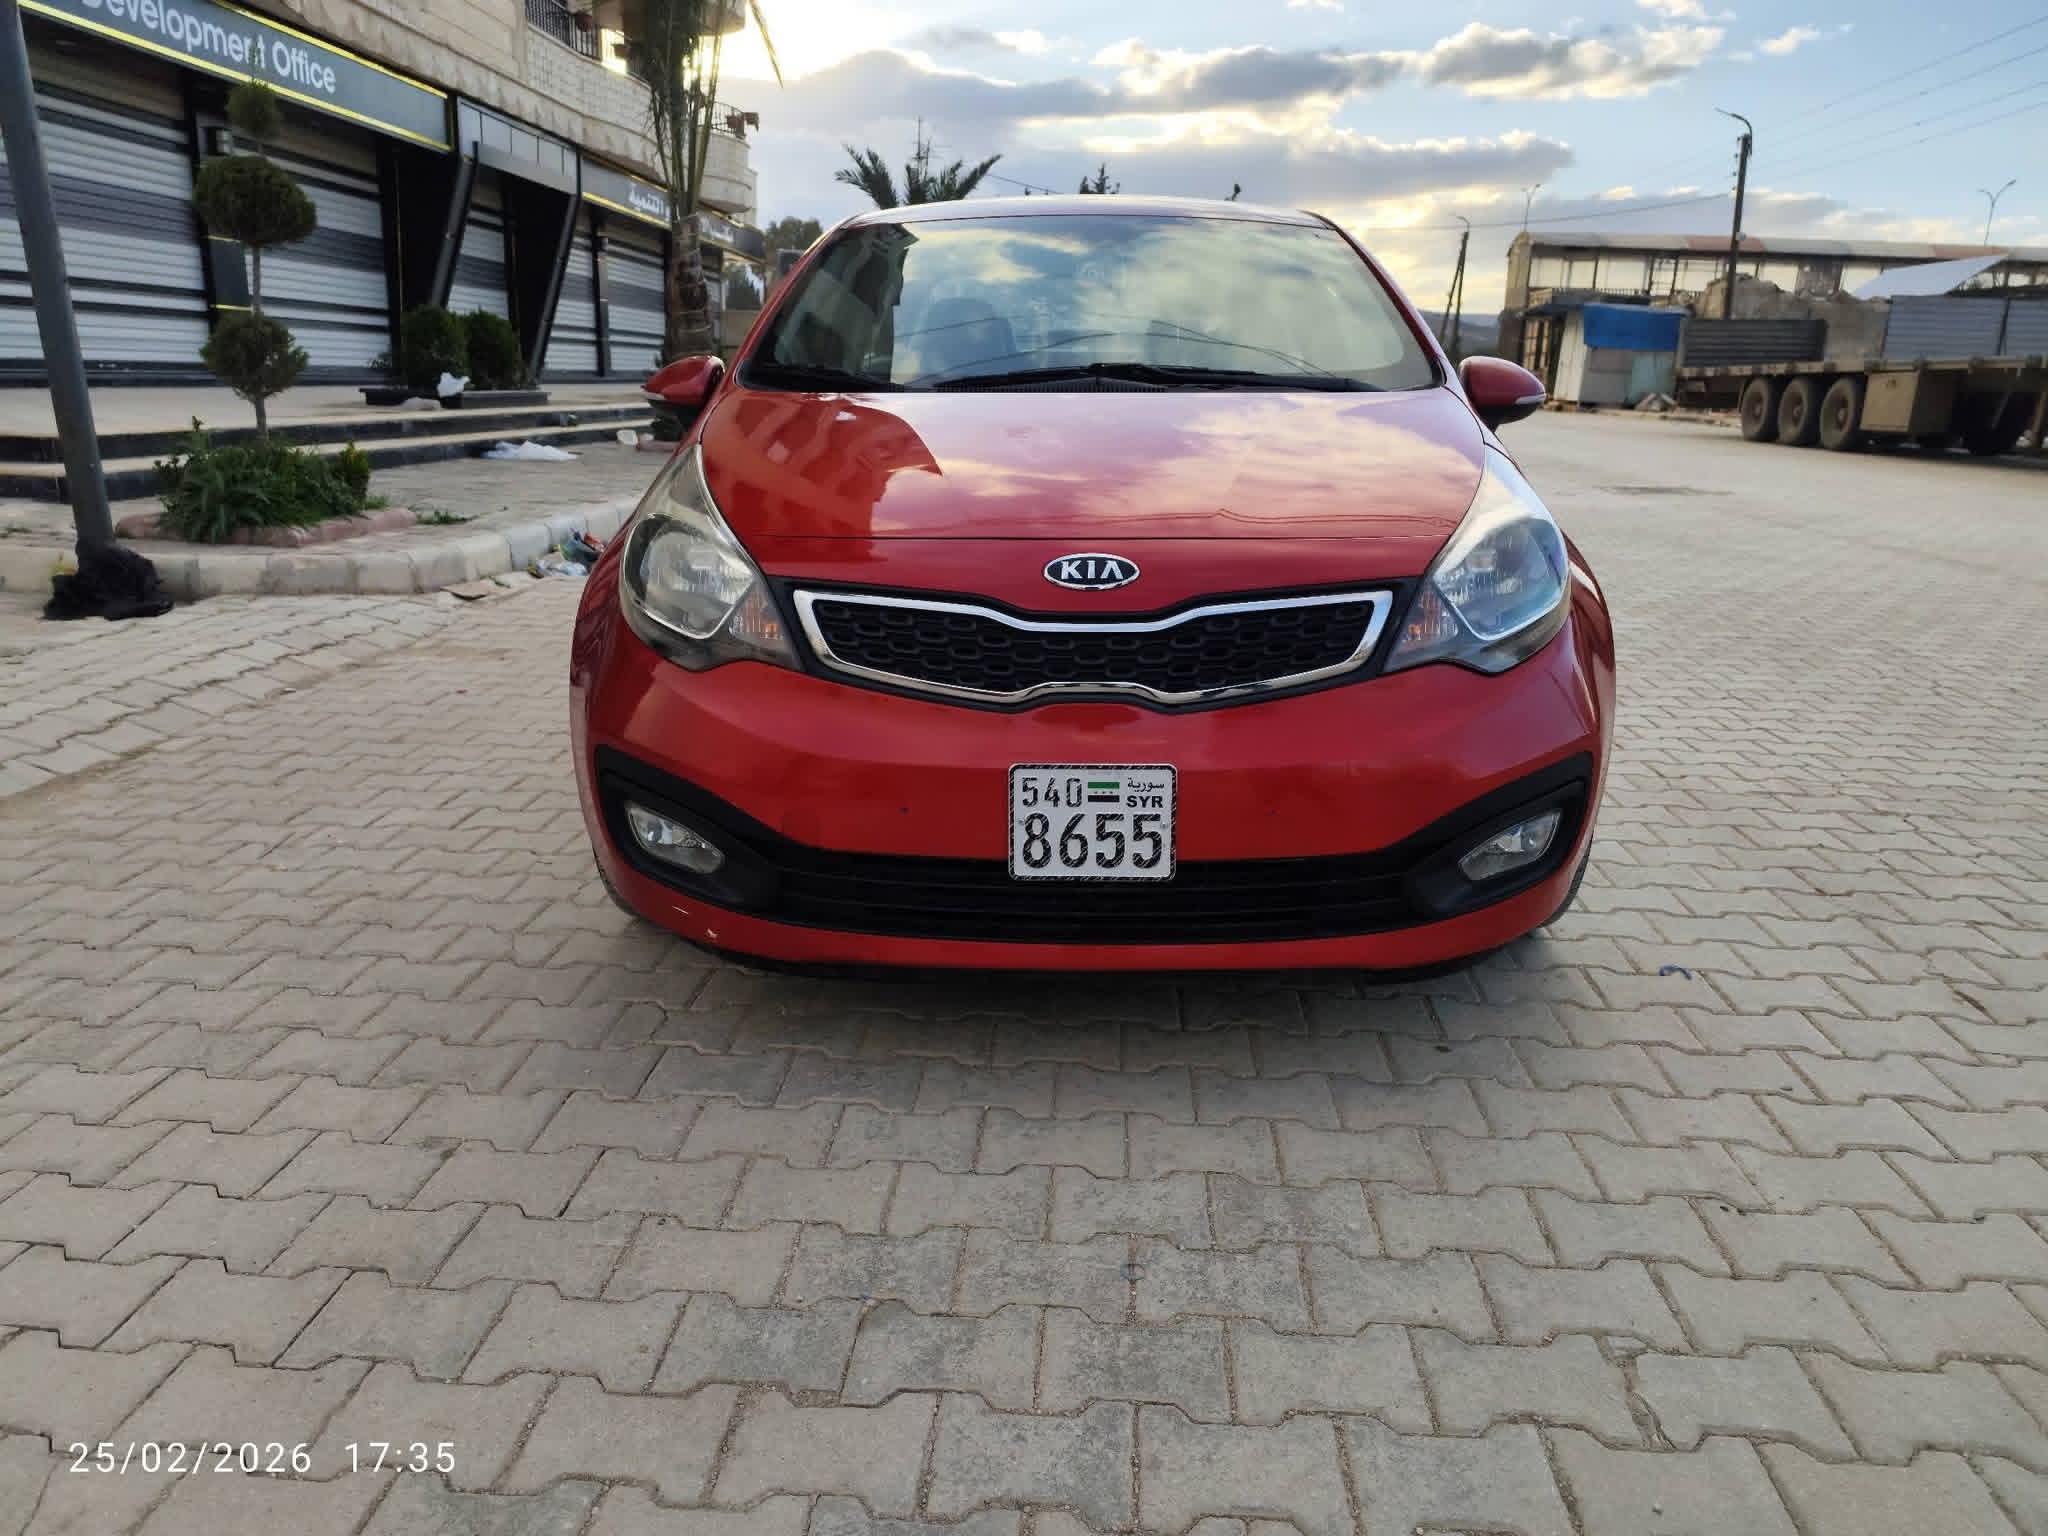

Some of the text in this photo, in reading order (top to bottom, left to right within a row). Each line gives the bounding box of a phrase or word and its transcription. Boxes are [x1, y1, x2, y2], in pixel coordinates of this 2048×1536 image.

[81, 0, 336, 94] evelopment Office
[1061, 559, 1124, 579] KIA
[1022, 777, 1082, 808] 540
[1127, 777, 1164, 792] سورية
[1126, 795, 1163, 808] SYR
[1022, 813, 1163, 869] 8655
